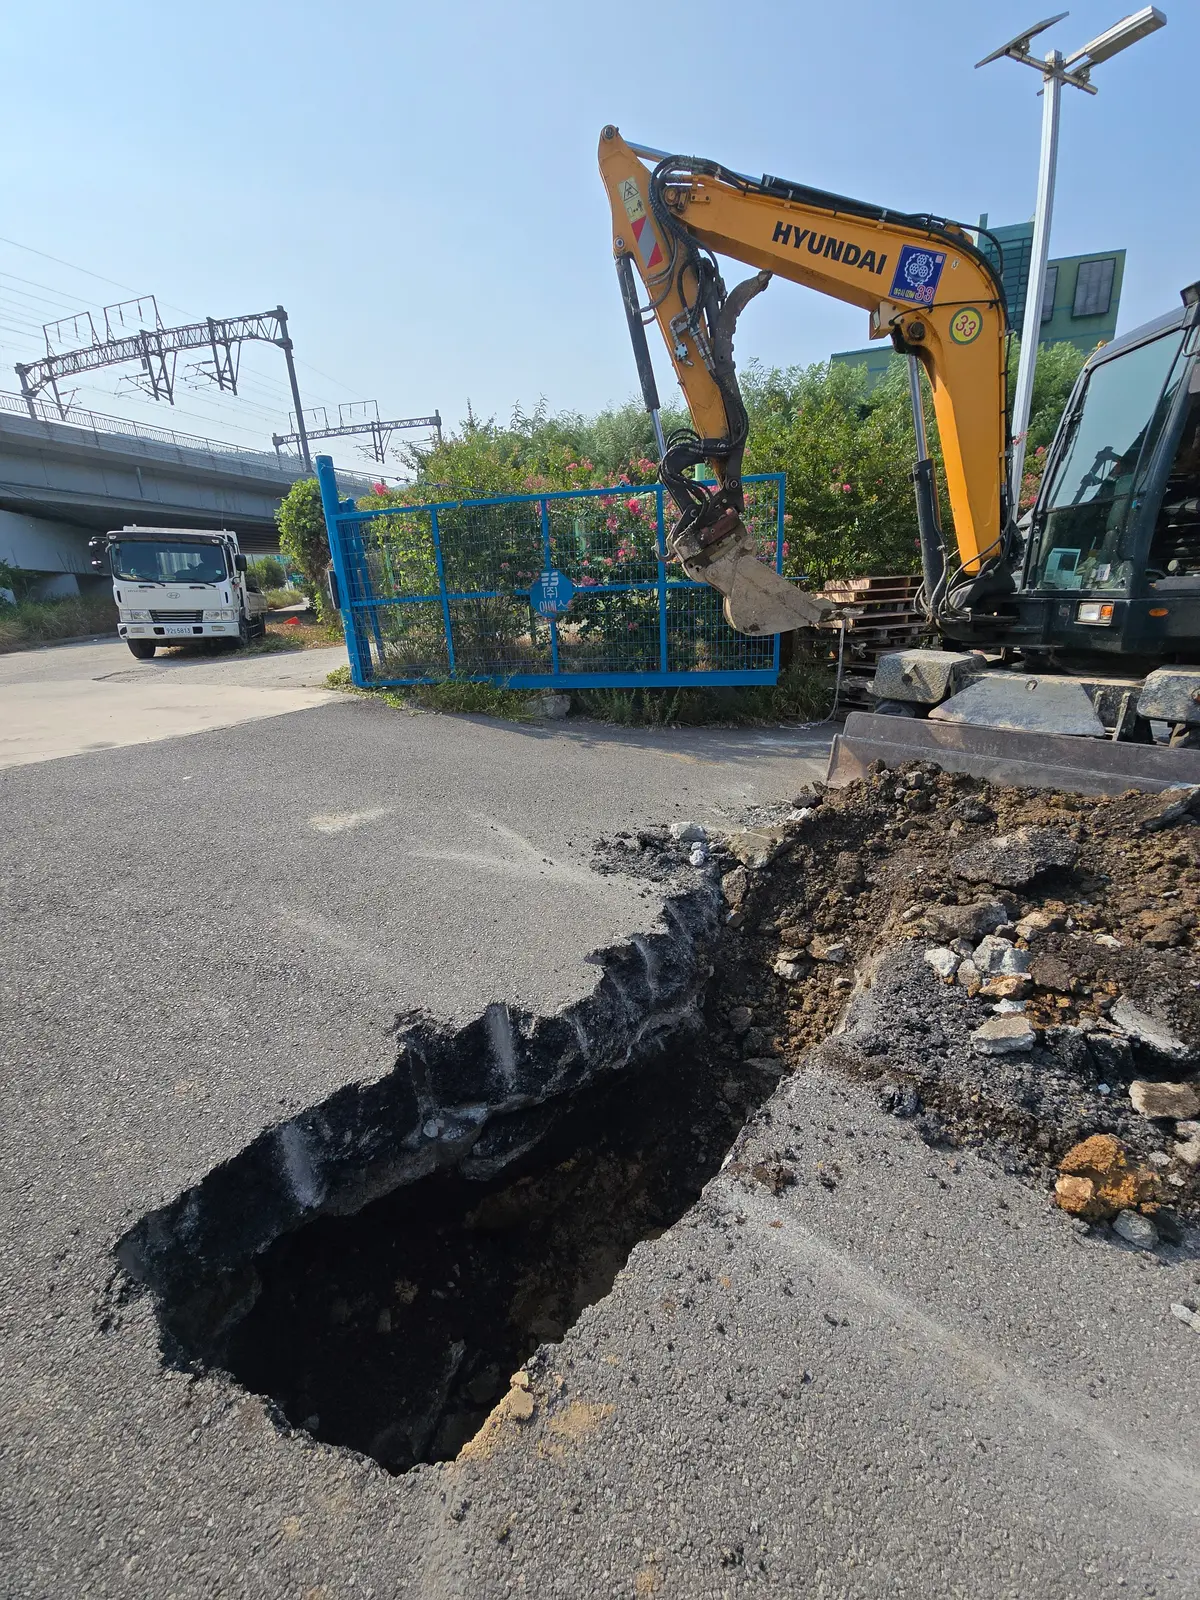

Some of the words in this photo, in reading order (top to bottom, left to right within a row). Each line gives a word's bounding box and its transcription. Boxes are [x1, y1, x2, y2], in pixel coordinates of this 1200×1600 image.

[772, 220, 888, 275] HYUNDAI
[915, 285, 934, 302] 33
[955, 314, 976, 337] 33
